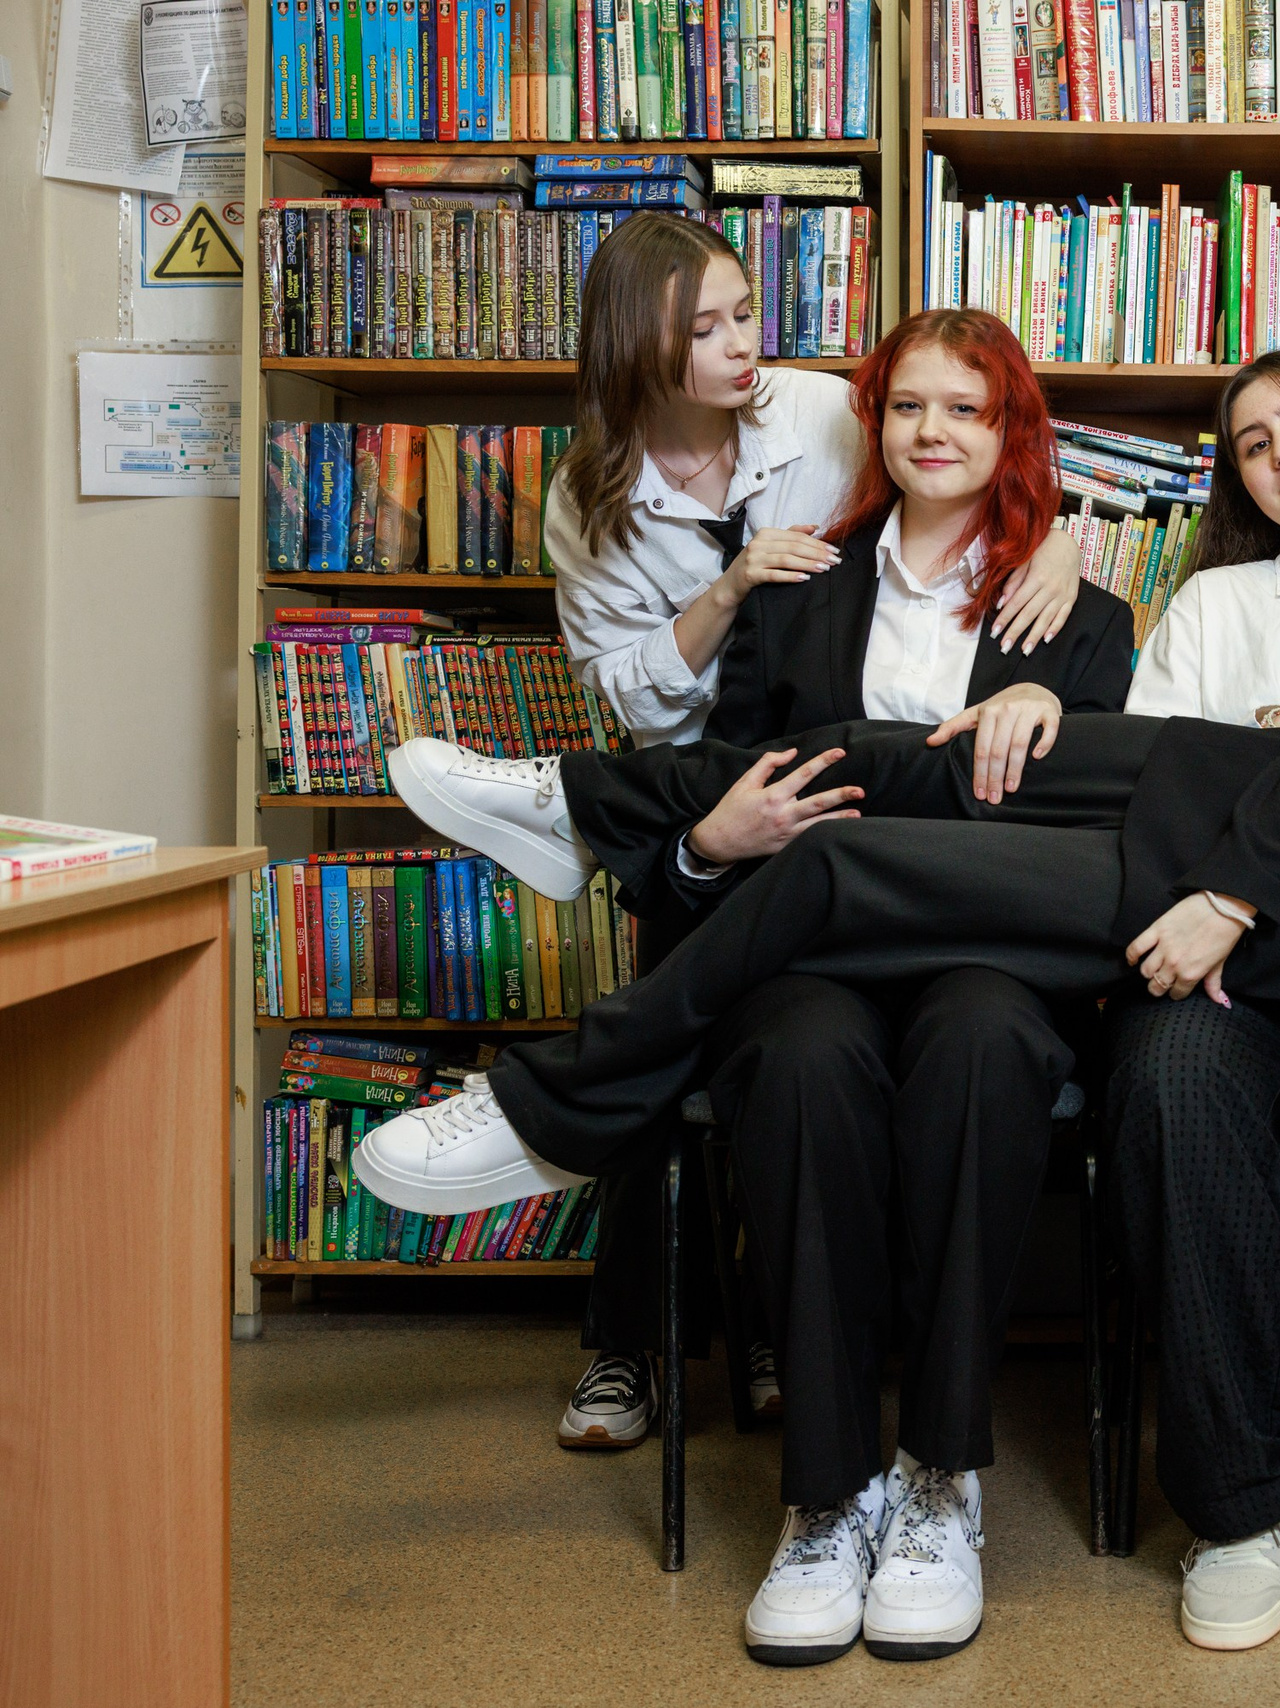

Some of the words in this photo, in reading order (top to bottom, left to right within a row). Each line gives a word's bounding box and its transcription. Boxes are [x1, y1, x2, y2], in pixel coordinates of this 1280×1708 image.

[279, 55, 289, 79] добра
[367, 55, 377, 79] добра
[1171, 54, 1181, 82] ДЕБРЯХ
[279, 81, 289, 120] Рассадник
[332, 69, 342, 120] Возвращение
[368, 81, 378, 120] Рассадник
[350, 98, 358, 120] Казак
[785, 259, 794, 283] НАМИ
[785, 284, 793, 302] НАД
[785, 302, 793, 333] НИКОГО
[849, 322, 860, 340] ДИН
[280, 699, 288, 722] ВОР
